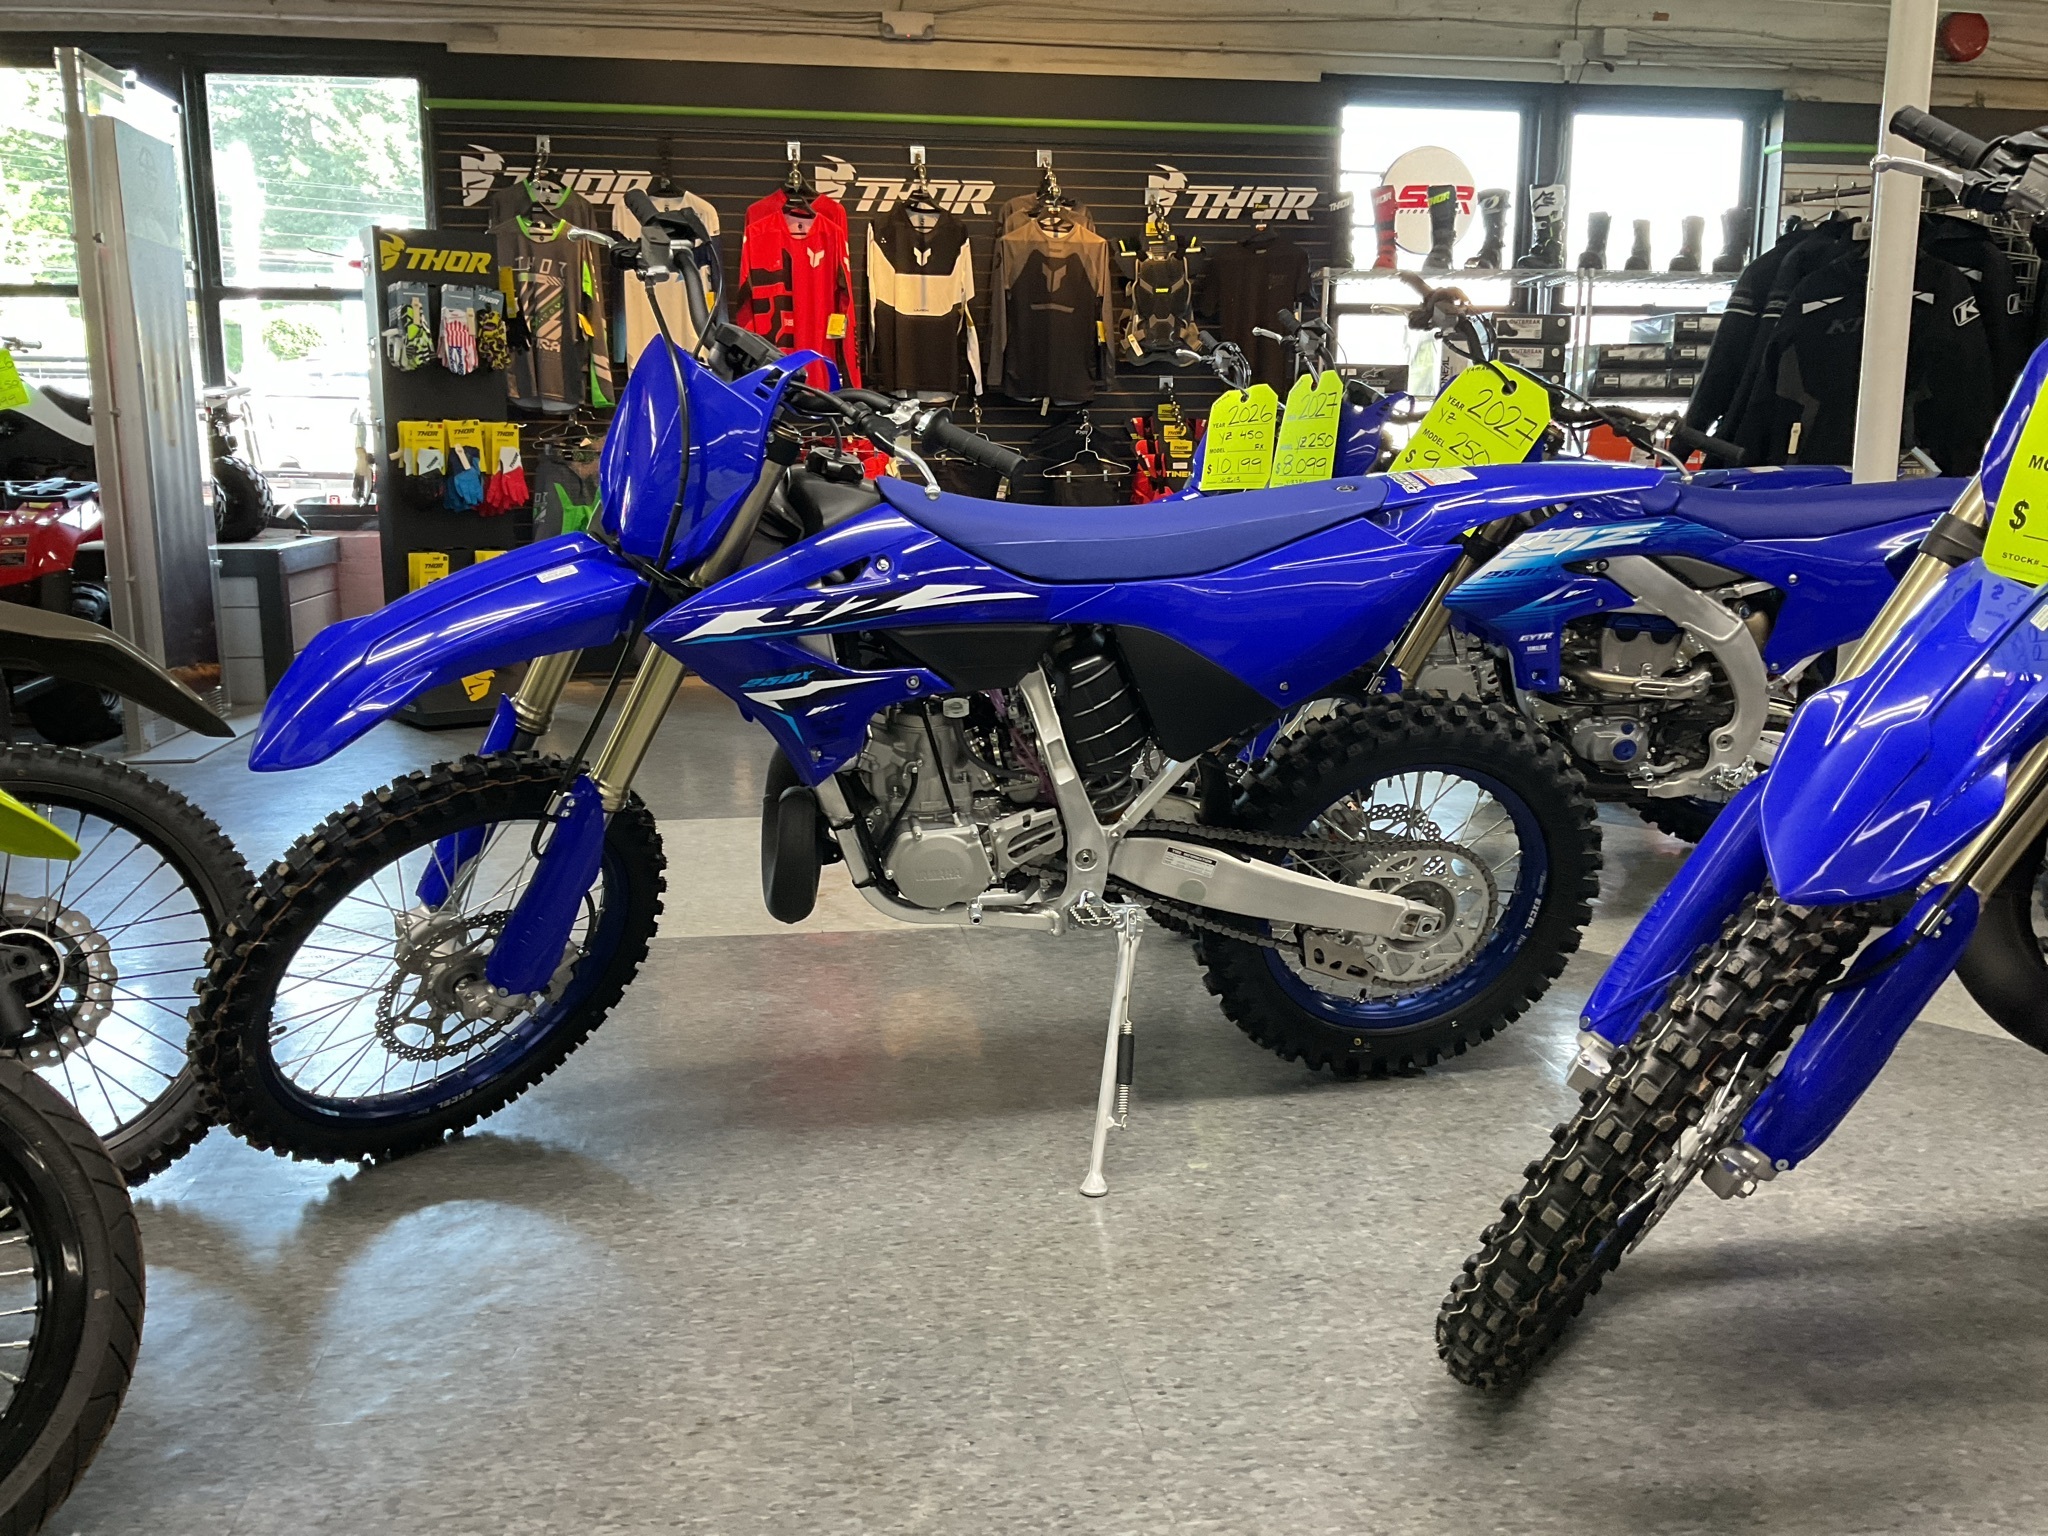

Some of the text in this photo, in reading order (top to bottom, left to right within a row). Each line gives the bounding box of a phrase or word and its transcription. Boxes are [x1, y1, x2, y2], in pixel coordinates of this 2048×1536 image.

[855, 177, 996, 215] THOR
[1185, 185, 1318, 221] THOR
[1397, 185, 1475, 214] SR
[405, 247, 492, 274] THOR
[1228, 404, 1273, 425] 2026
[1298, 392, 1338, 419] 2027
[1447, 389, 1537, 446] YEAR 2027
[1240, 430, 1264, 440] 450
[1422, 428, 1490, 465] MODEL 250
[424, 562, 444, 570] THOR
[2001, 551, 2040, 566] STOCK#
[739, 670, 816, 688] 250X
